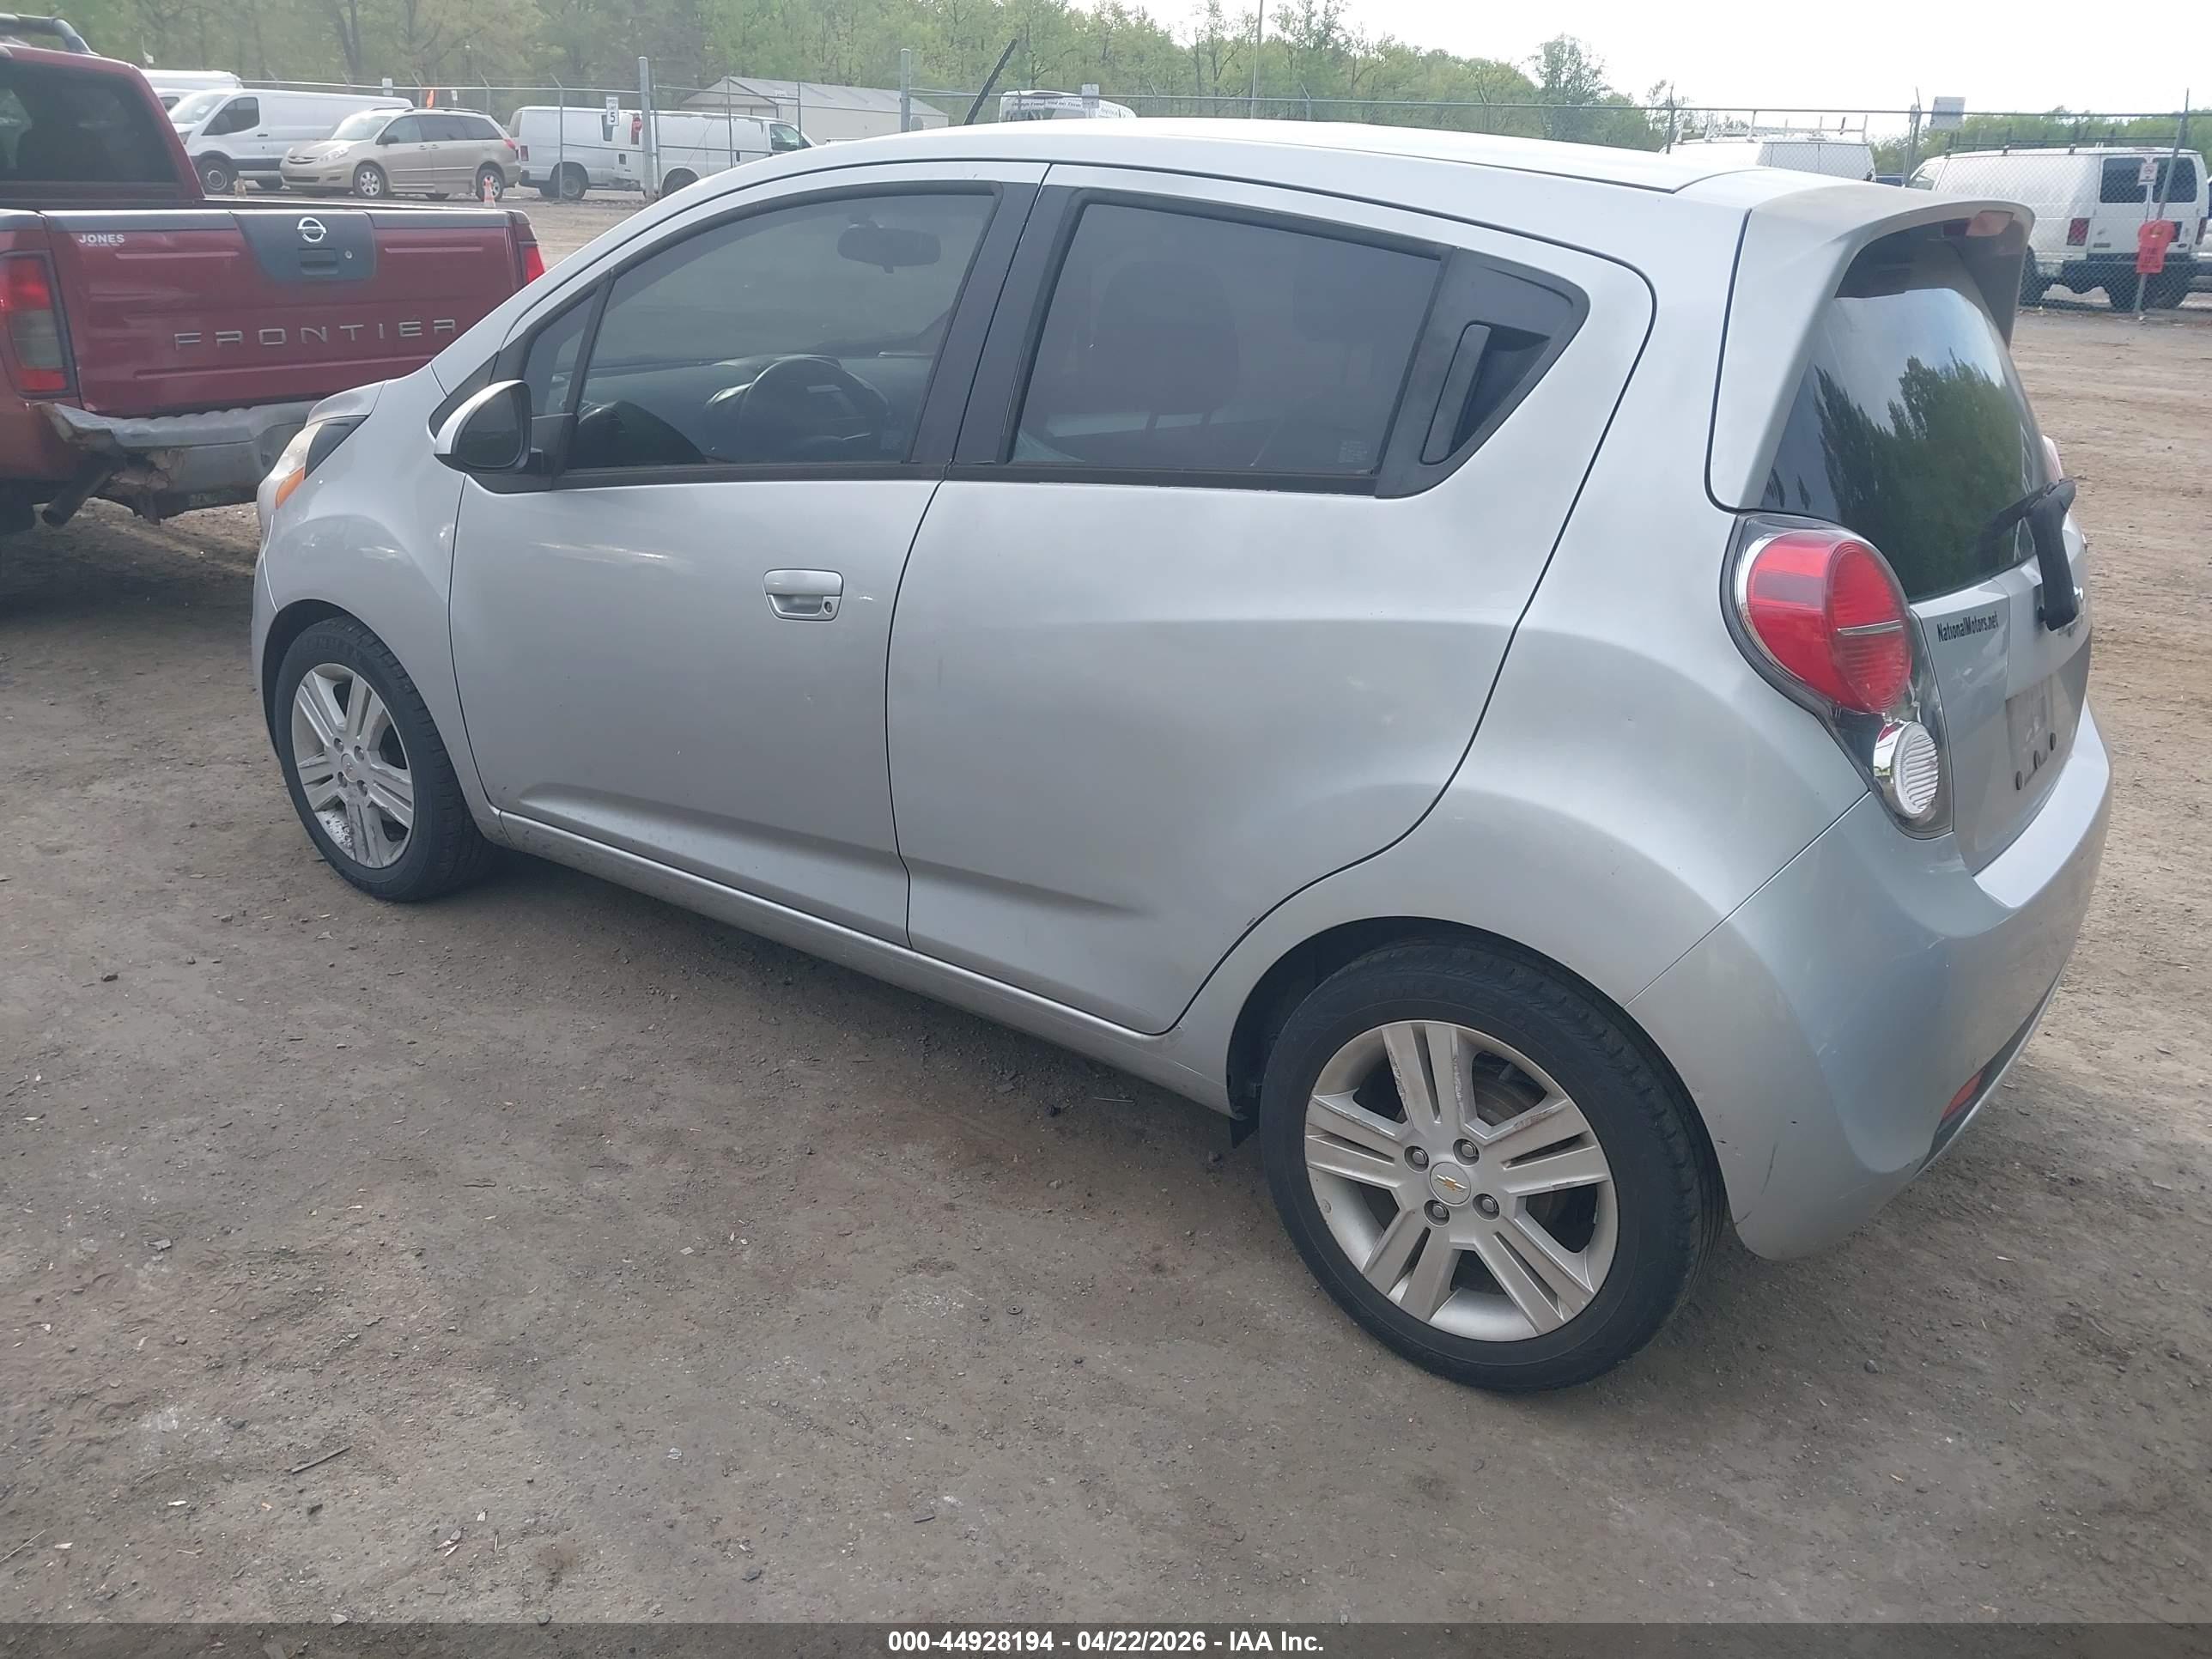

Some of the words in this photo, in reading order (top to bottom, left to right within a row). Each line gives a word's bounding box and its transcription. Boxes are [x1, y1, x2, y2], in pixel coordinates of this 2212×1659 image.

[610, 112, 616, 123] 5
[78, 234, 125, 244] JONES
[174, 319, 456, 350] FRONTIER
[1936, 611, 1999, 642] NationalMotors.net
